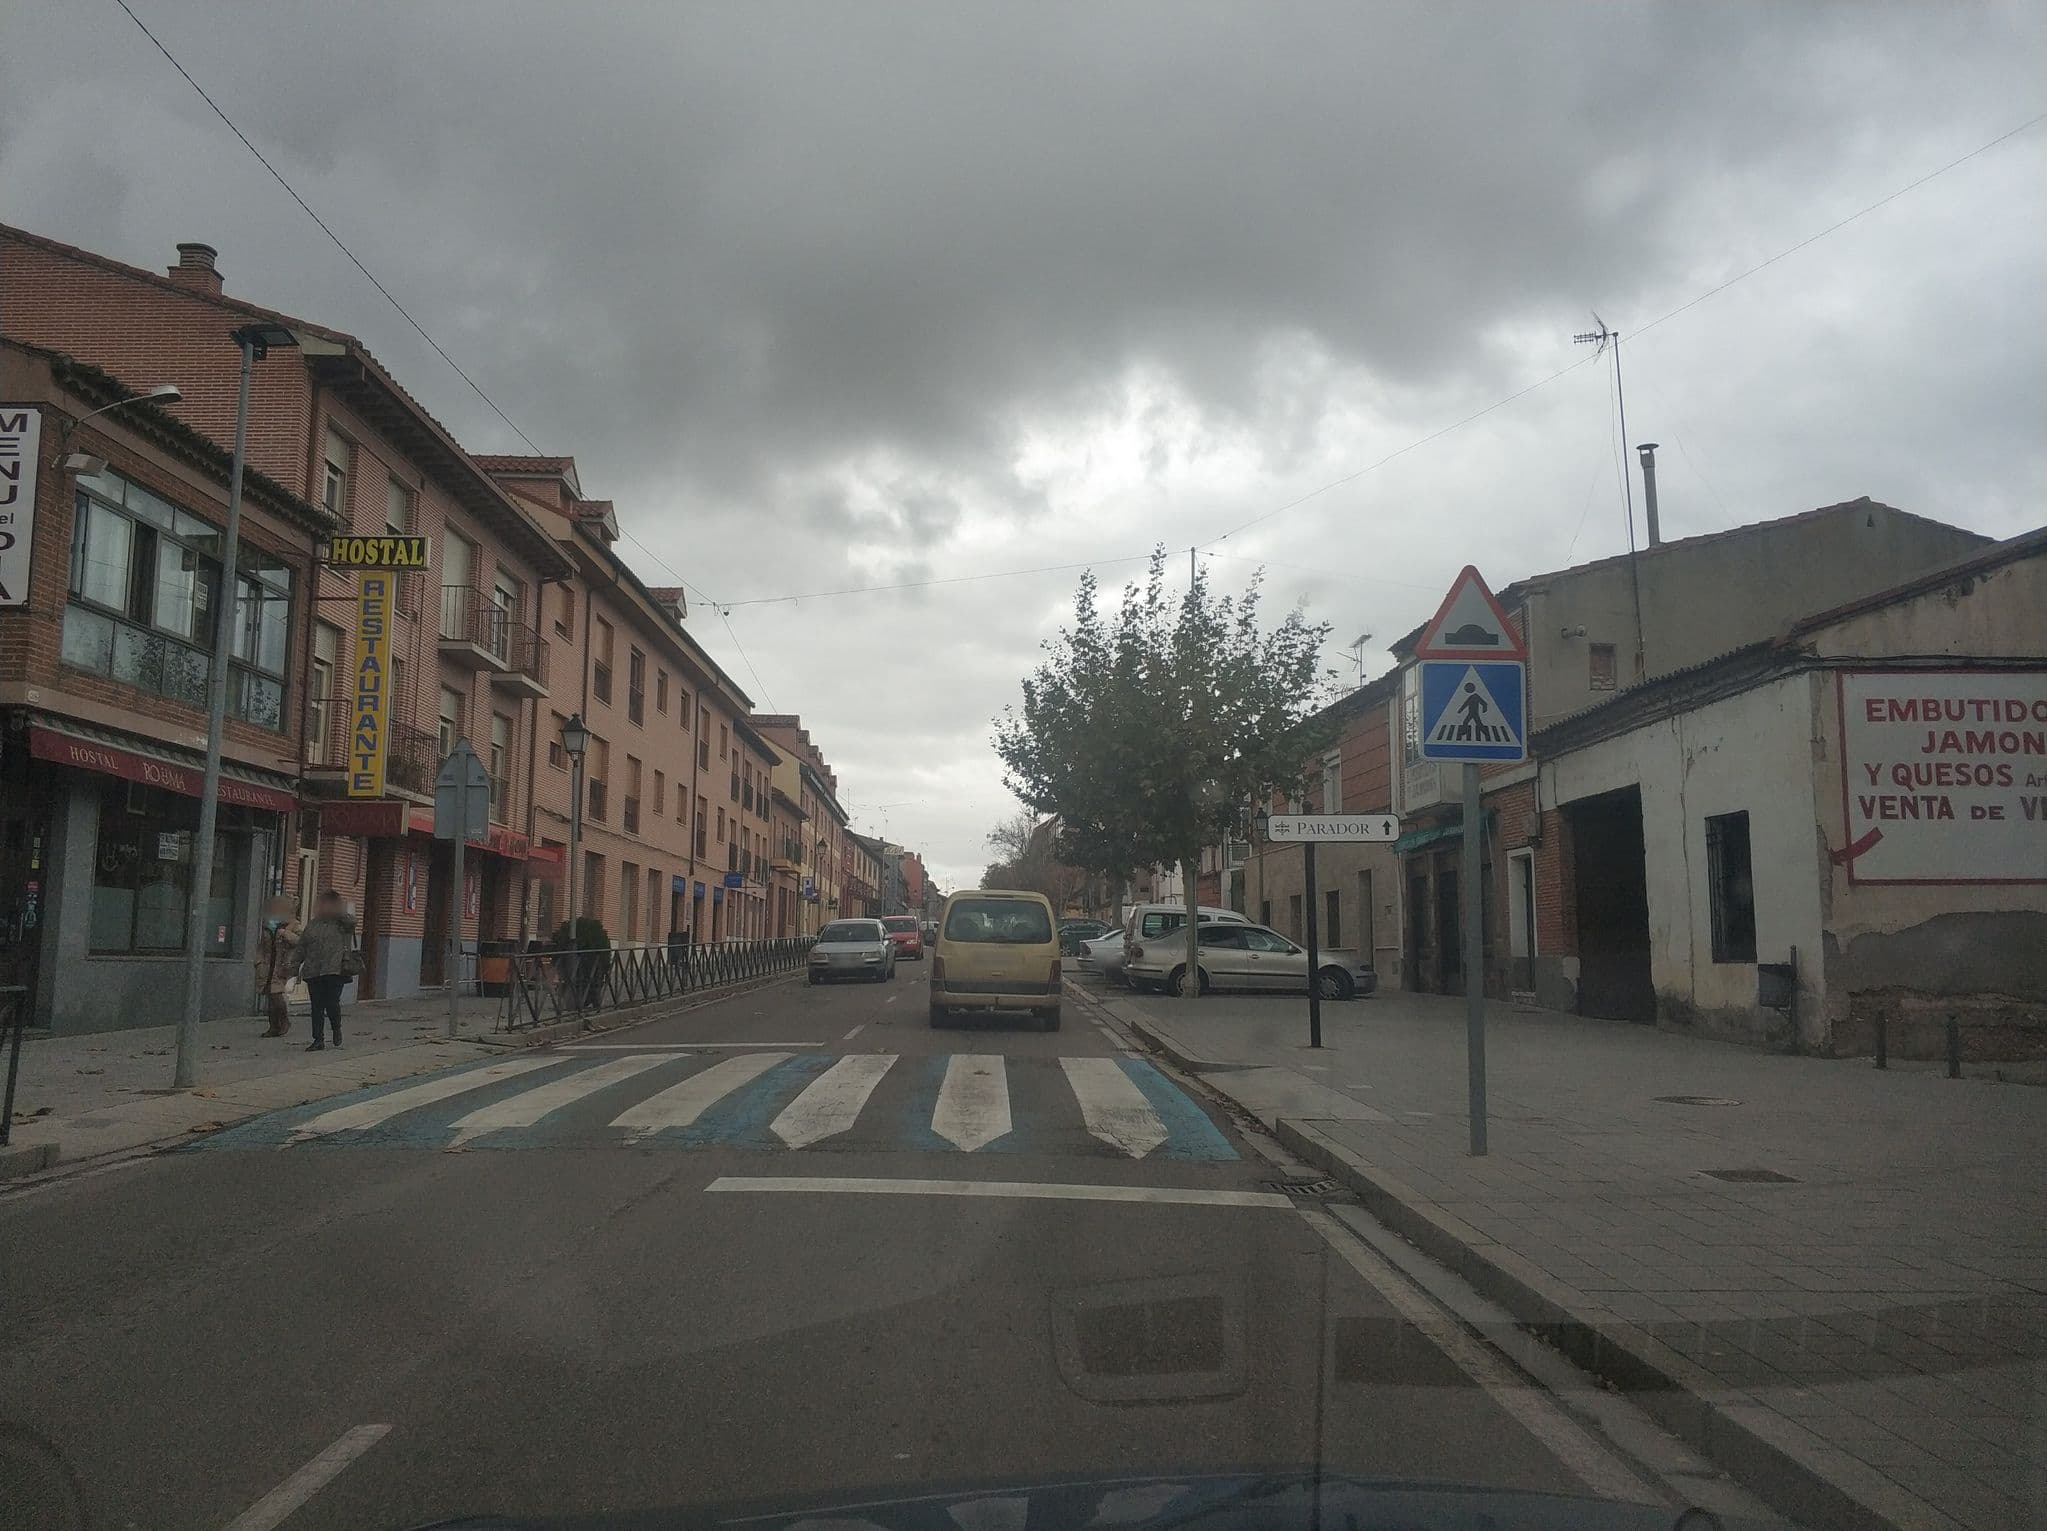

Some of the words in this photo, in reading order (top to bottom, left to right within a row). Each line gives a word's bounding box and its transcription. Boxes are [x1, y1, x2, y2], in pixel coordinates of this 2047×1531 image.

[332, 539, 424, 566] HOSTAL
[353, 579, 385, 791] RESTAURANTE
[1921, 730, 2046, 755] JAMON
[69, 745, 119, 770] HOSTAL
[1863, 762, 1883, 786] Y
[1891, 762, 2014, 792] QUESOS
[1858, 795, 1955, 820] VENTA
[1970, 805, 2005, 820] DE
[1297, 822, 1370, 835] PARADOR
